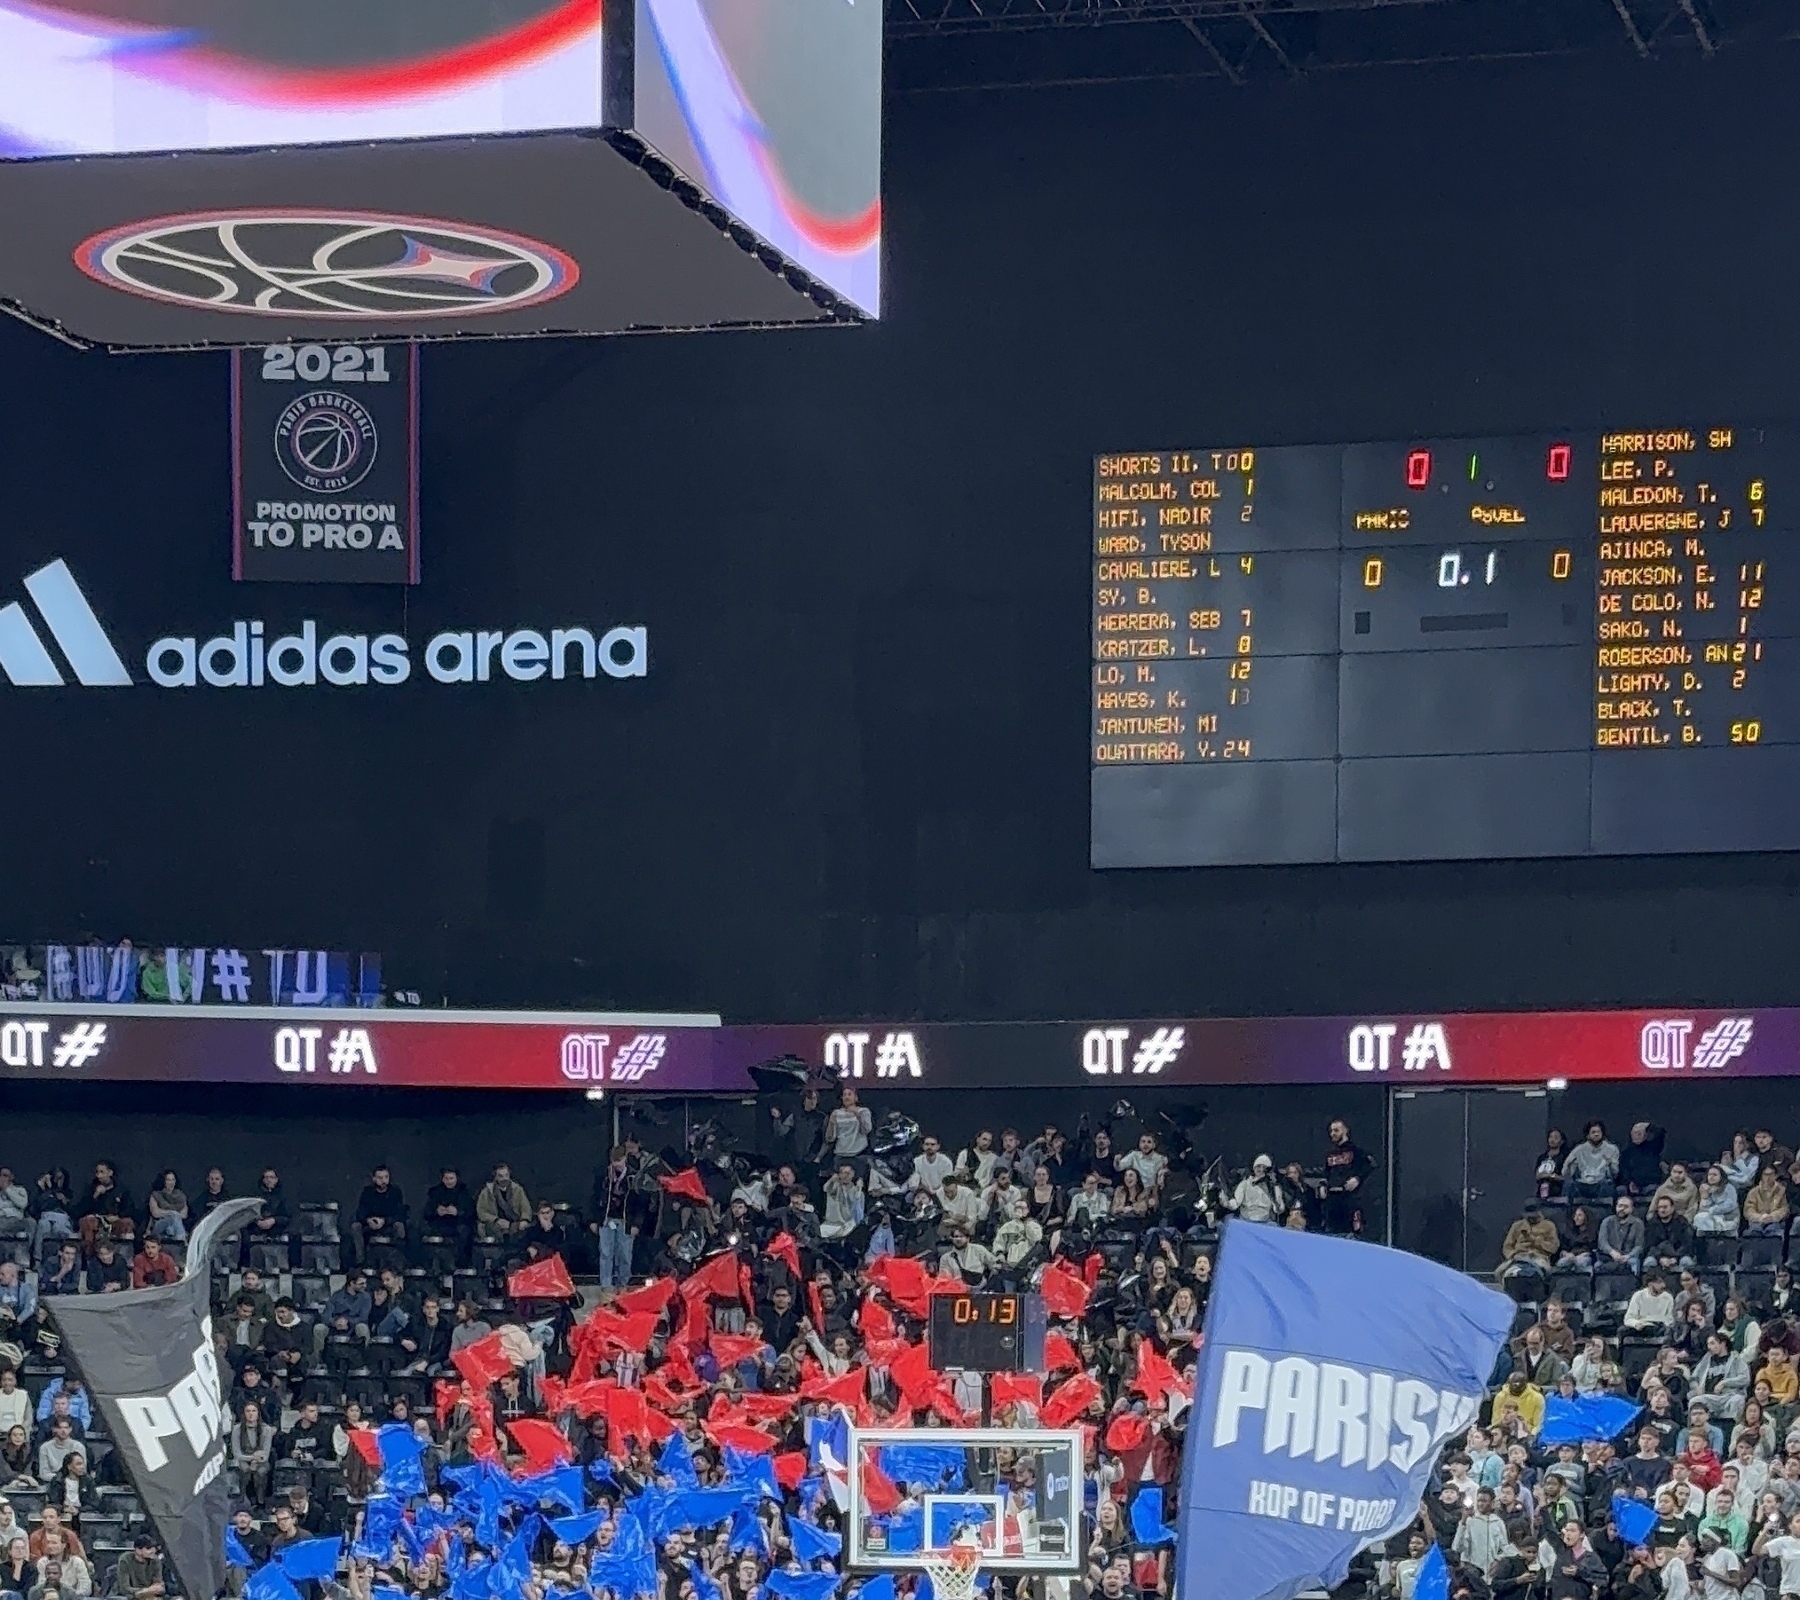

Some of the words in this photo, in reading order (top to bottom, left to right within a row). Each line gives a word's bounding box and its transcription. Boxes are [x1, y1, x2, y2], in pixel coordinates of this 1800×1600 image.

[262, 345, 390, 382] 2021
[1602, 432, 1695, 453] HARRISON,
[1708, 430, 1732, 448] SH
[1099, 456, 1161, 476] SHORTS
[1408, 453, 1430, 486] 0
[1549, 447, 1571, 479] 0
[1601, 460, 1643, 480] LEE,
[1654, 459, 1675, 478] P.
[1099, 482, 1178, 501] MALCOLM,
[1190, 479, 1221, 498] COL
[1601, 486, 1684, 506] MALEDON,
[1697, 483, 1717, 504] T.
[1750, 482, 1763, 501] 6
[256, 502, 396, 522] PROMOTION
[1099, 508, 1147, 528] HIFI,
[1159, 506, 1212, 526] NADIR
[1241, 504, 1253, 522] 2
[1718, 509, 1731, 528] J
[1751, 508, 1764, 526] 7
[247, 521, 295, 548] TO
[302, 523, 373, 550] PRO
[377, 524, 404, 550] A
[1098, 535, 1147, 554] WARD,
[1159, 532, 1212, 552] TYSON
[1600, 540, 1673, 560] AJINCA,
[1685, 538, 1706, 557] M.
[1098, 559, 1199, 581] CAVALIERE,
[1209, 557, 1221, 577] L
[1240, 556, 1252, 575] 4
[1364, 560, 1382, 586] 0
[1552, 553, 1570, 579] 0
[1600, 566, 1684, 586] JACKSON,
[1696, 564, 1716, 583] E.
[1098, 588, 1126, 607] SY,
[1138, 588, 1156, 605] B.
[1599, 594, 1622, 613] DE
[1632, 592, 1683, 612] COLO,
[1695, 590, 1716, 610] N.
[1740, 588, 1762, 608] 12
[1098, 612, 1177, 632] HERRERA,
[1188, 610, 1221, 629] SEB
[1240, 609, 1251, 627] 7
[1599, 620, 1650, 639] SAKO,
[1662, 618, 1683, 637] N.
[146, 621, 411, 687] adidas
[425, 625, 648, 686] arena
[1098, 638, 1176, 658] KRATZER,
[1188, 637, 1207, 656] L.
[1704, 644, 1728, 663] AN
[1097, 666, 1125, 684] LO,
[1230, 661, 1251, 680] 12
[1598, 672, 1671, 693] LIGHTY,
[1683, 672, 1703, 691] D.
[1732, 669, 1746, 689] 2
[1097, 691, 1156, 709] HAYES,
[1167, 690, 1187, 709] K.
[1598, 699, 1660, 719] BLACK,
[1672, 699, 1691, 717] T.
[1097, 716, 1186, 735] JANTUNEN,
[1197, 715, 1218, 734] MI
[1096, 741, 1185, 761] OUATTARA,
[1223, 739, 1251, 758] 24
[1249, 1480, 1299, 1519] KOP
[1301, 1490, 1336, 1527] OF
